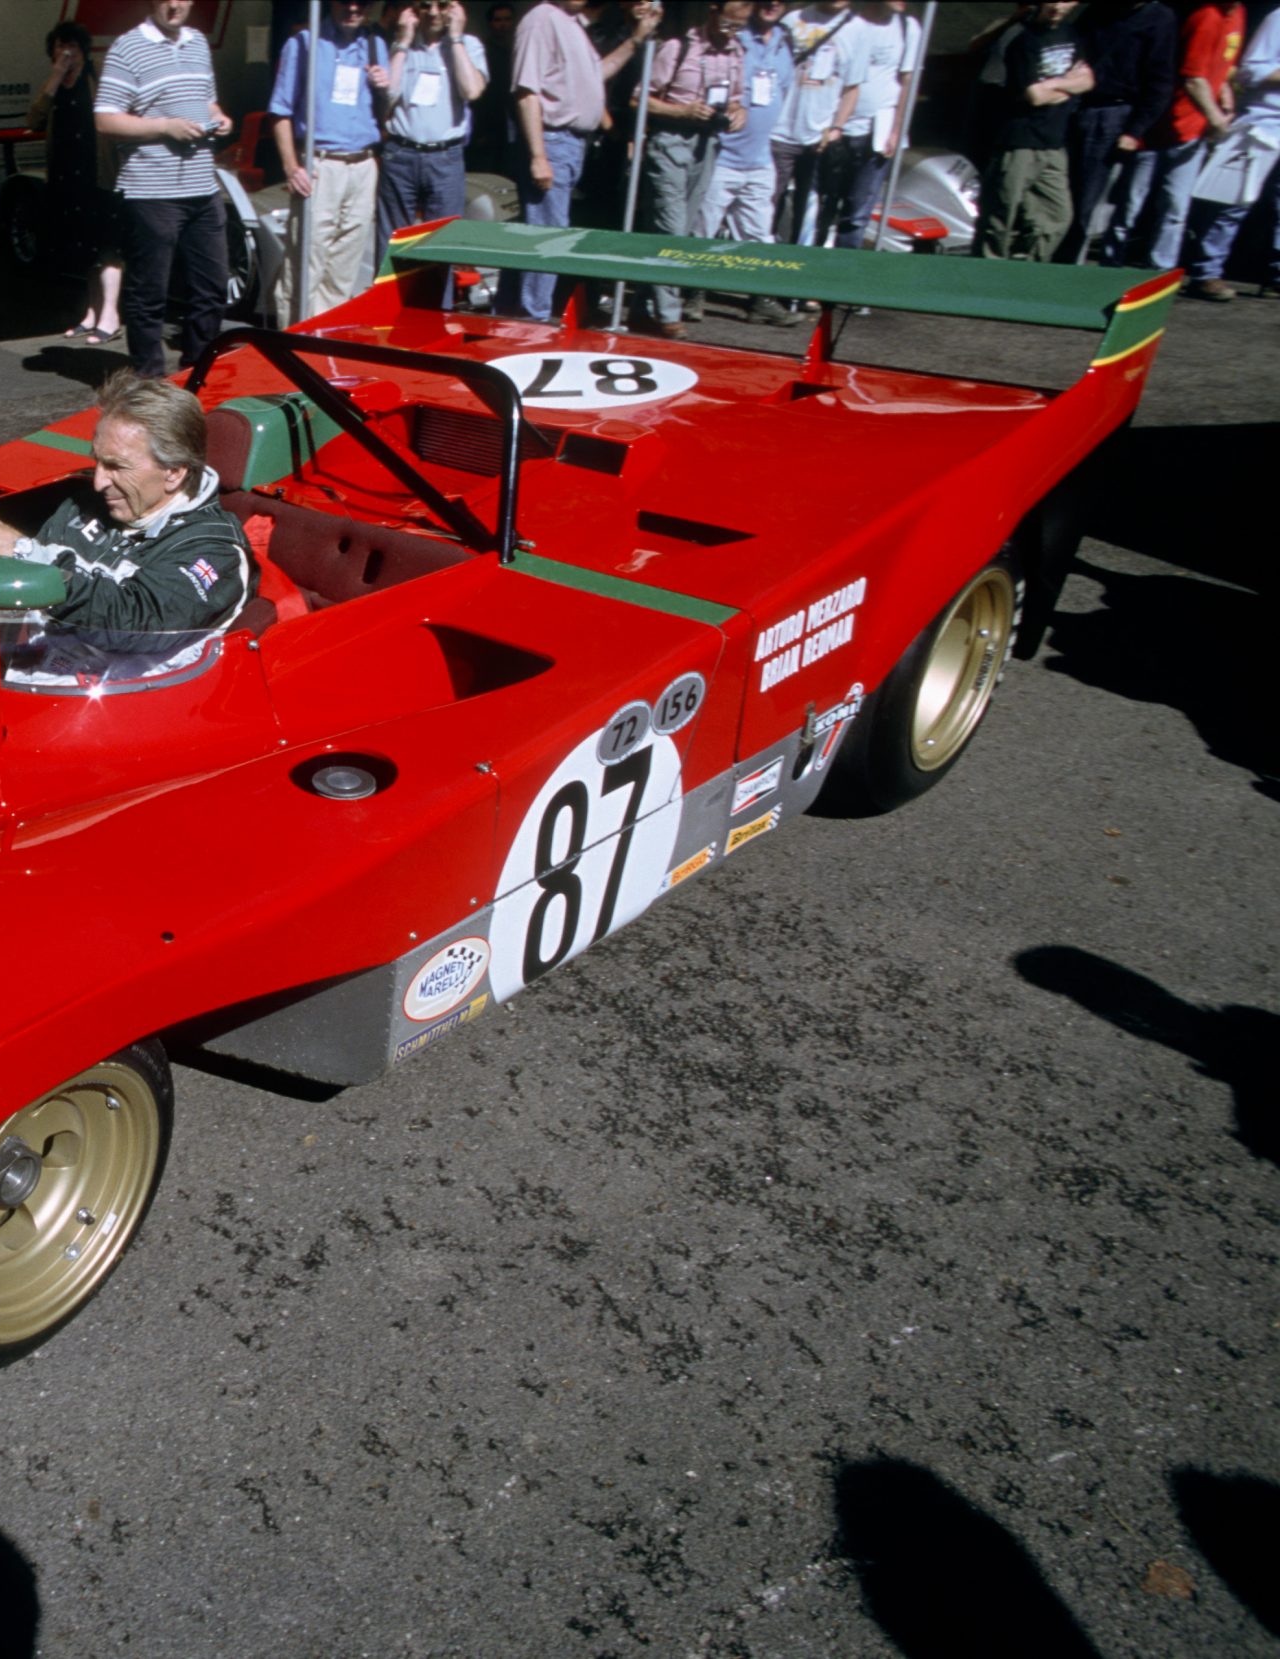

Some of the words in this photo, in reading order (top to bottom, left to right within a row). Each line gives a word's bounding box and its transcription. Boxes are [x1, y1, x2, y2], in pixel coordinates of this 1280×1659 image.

[522, 358, 659, 398] 87
[660, 684, 697, 726] 156
[612, 715, 638, 752] 72
[521, 743, 654, 985] 87
